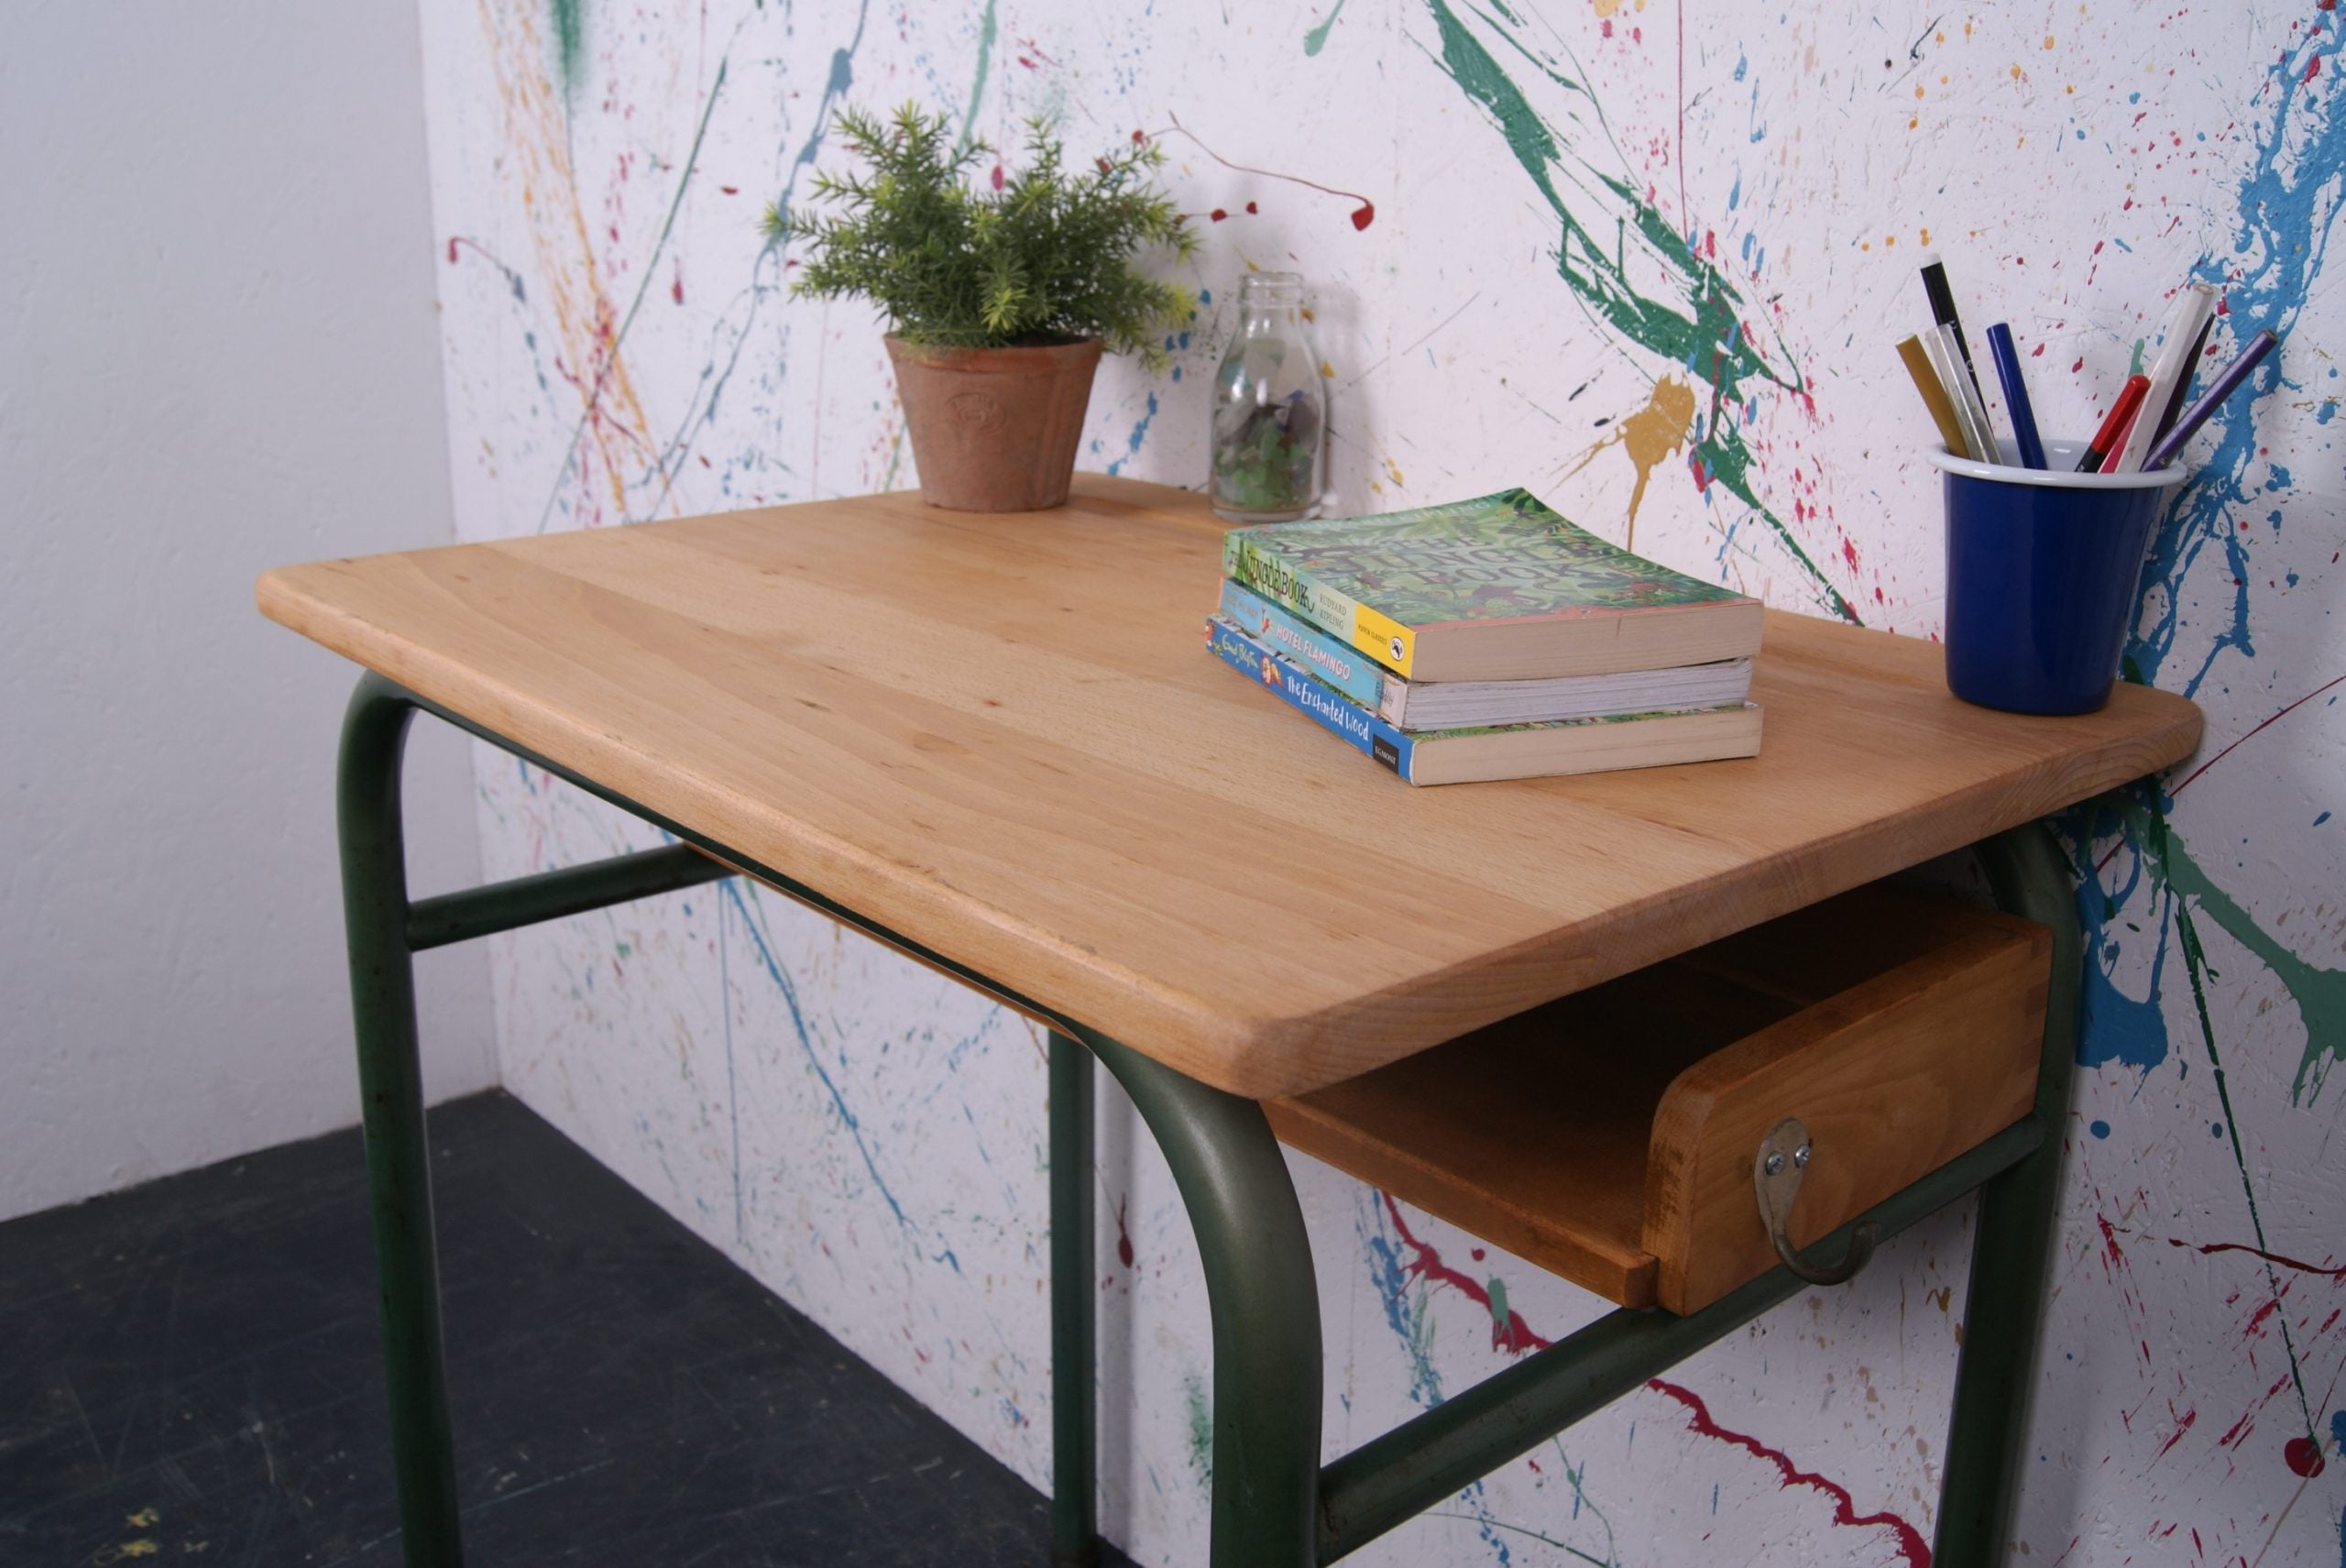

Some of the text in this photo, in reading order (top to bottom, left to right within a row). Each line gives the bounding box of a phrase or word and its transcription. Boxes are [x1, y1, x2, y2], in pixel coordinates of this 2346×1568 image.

[1243, 550, 1281, 592] JUNGLE
[1281, 571, 1315, 614] BOOK
[1393, 563, 1595, 592] BOOK
[1320, 610, 1344, 631] KIPLING
[1277, 624, 1351, 680] HOTEL FLAMINGO
[1288, 675, 1369, 741] The Enchanted Wood
[1375, 745, 1397, 764] EGMONT
